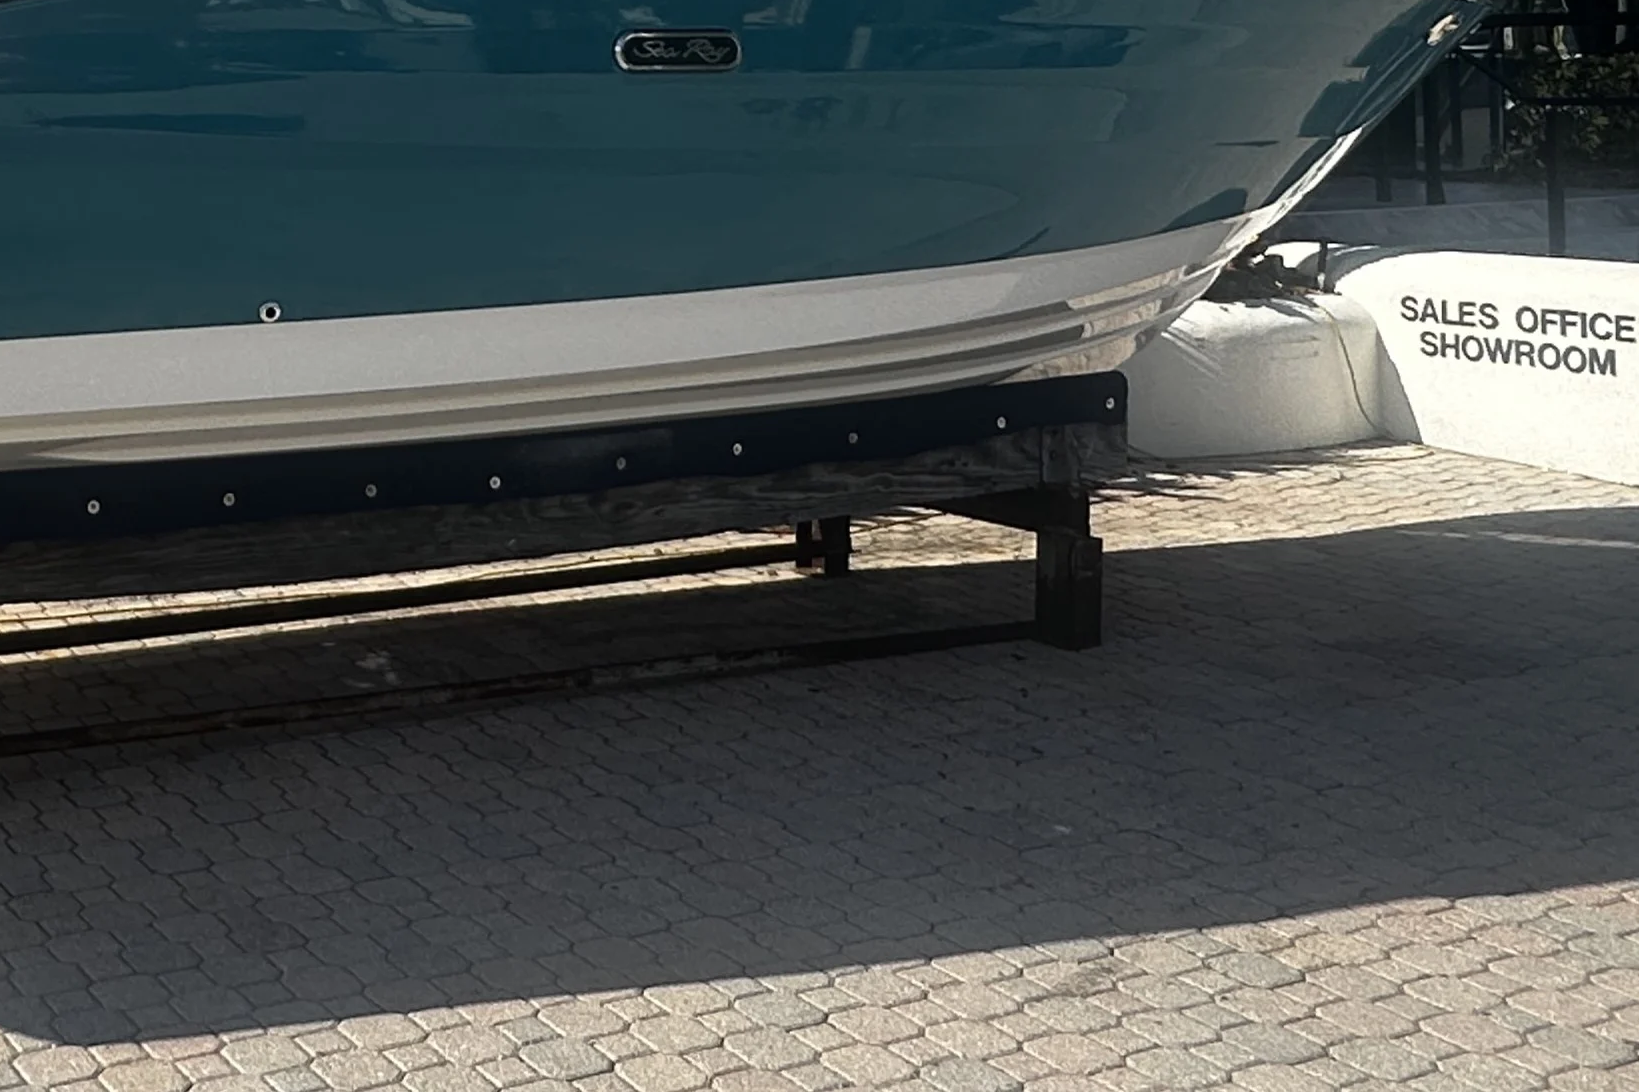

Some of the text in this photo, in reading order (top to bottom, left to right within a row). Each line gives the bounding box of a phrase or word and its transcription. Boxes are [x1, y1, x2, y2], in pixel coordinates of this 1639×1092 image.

[633, 39, 731, 63] Sea Ray
[1400, 296, 1637, 343] SALES OFFICE
[1420, 331, 1617, 377] SHOWROOM
